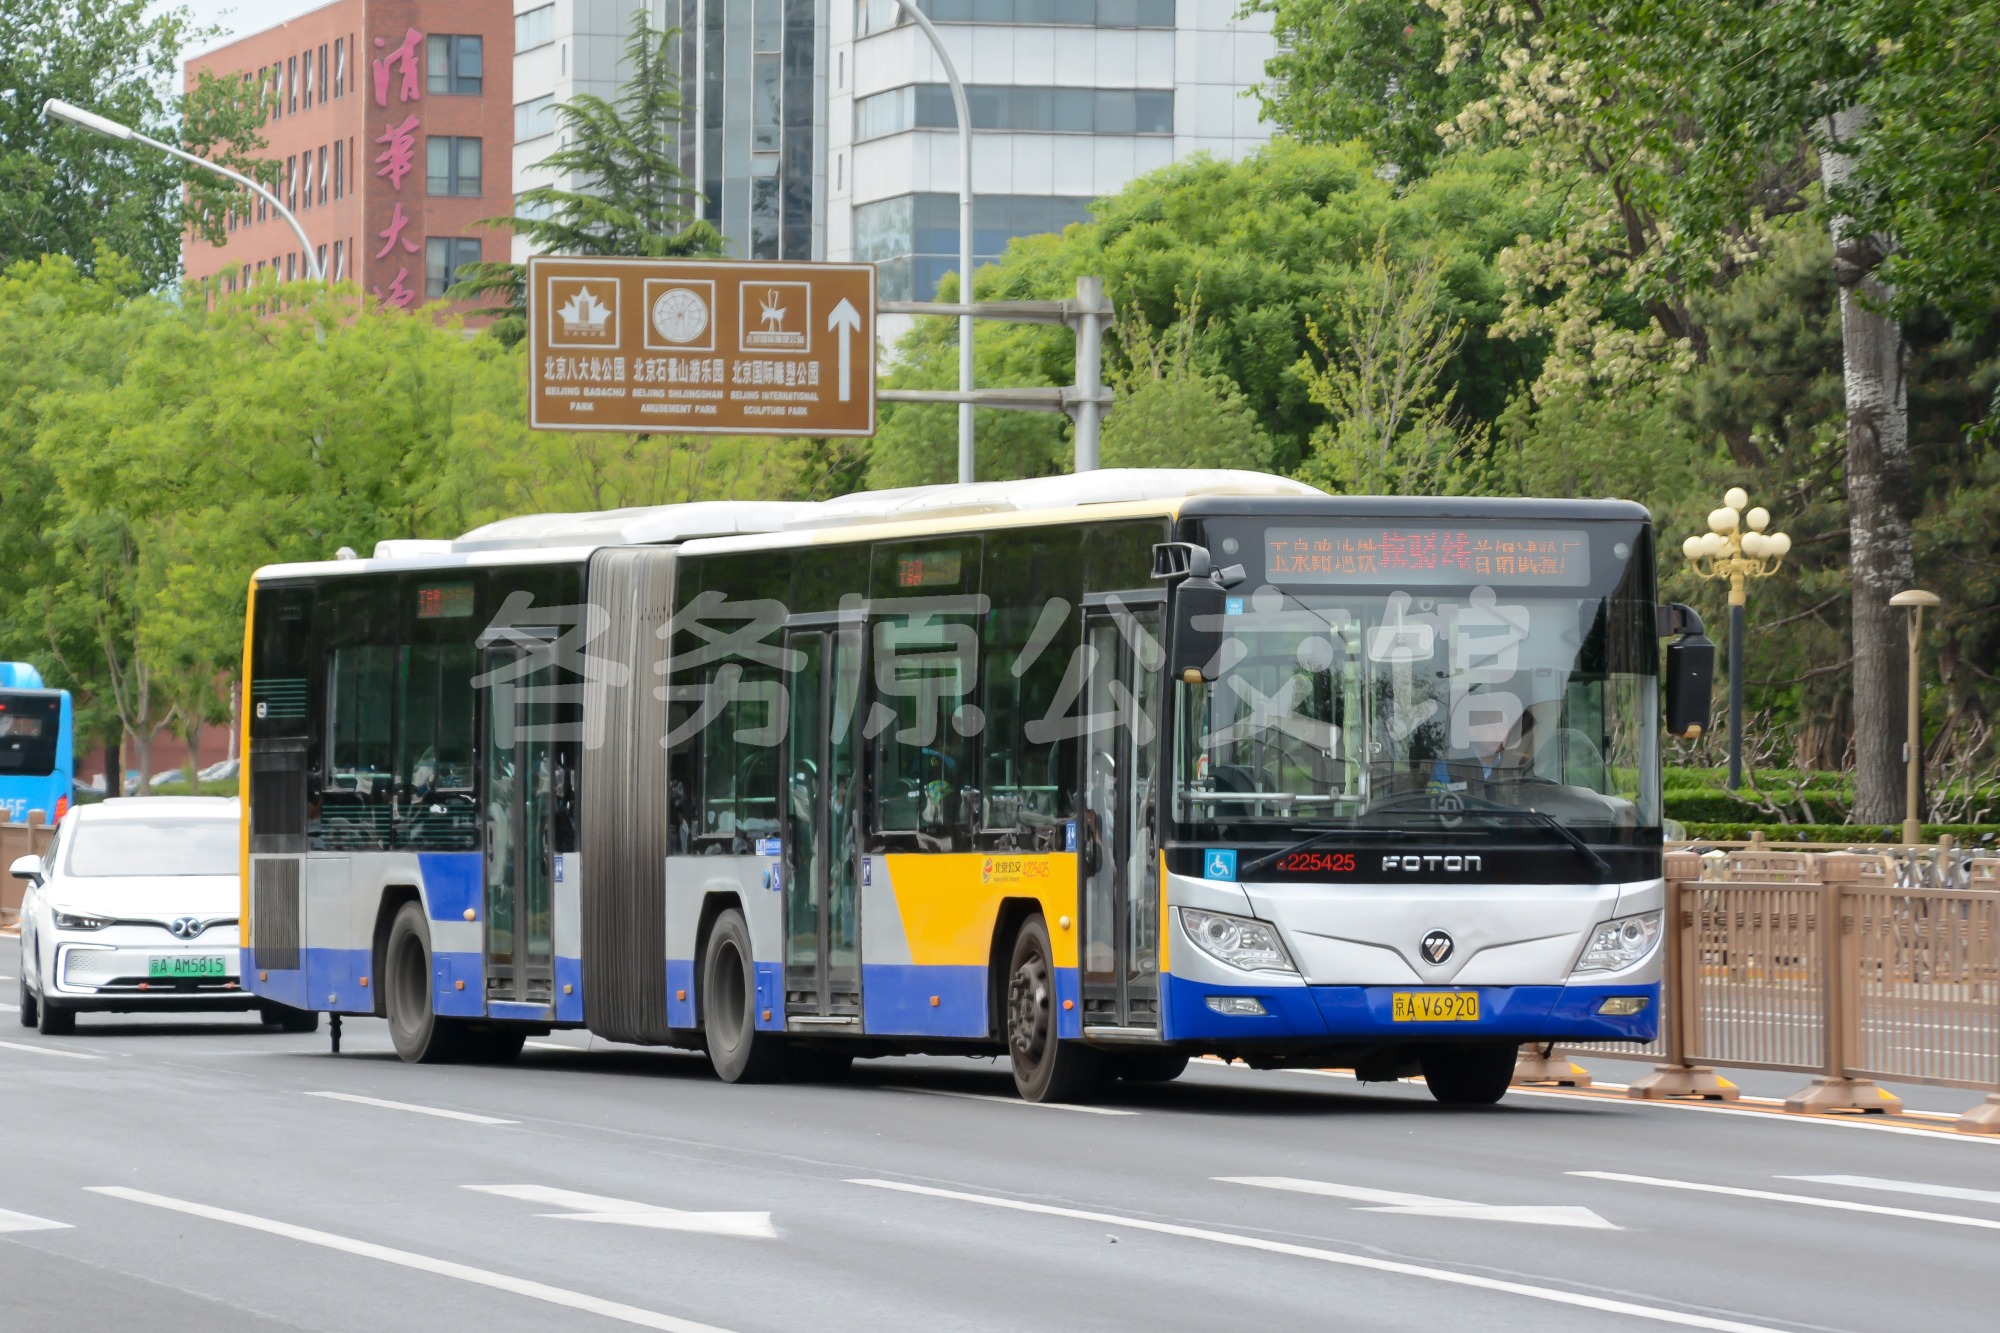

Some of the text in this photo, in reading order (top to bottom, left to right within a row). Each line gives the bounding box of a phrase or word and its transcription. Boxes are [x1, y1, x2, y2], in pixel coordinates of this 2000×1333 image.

[544, 356, 625, 382] 北京八大处公园
[633, 358, 724, 384] 北京石景山游乐园
[732, 360, 819, 386] 北京国际雕塑公园
[545, 387, 626, 397] BEIJING BADACHU
[632, 388, 724, 399] BEIJING SHIJINGSHAN
[730, 391, 819, 401] BEIJING INTERNATIONAL
[570, 402, 594, 411] PARK
[640, 403, 717, 414] AMUSEMENT PARK
[743, 405, 808, 416] SCULPTURE PARK
[994, 861, 1021, 874] 北京公交
[1381, 855, 1482, 872] FOTON
